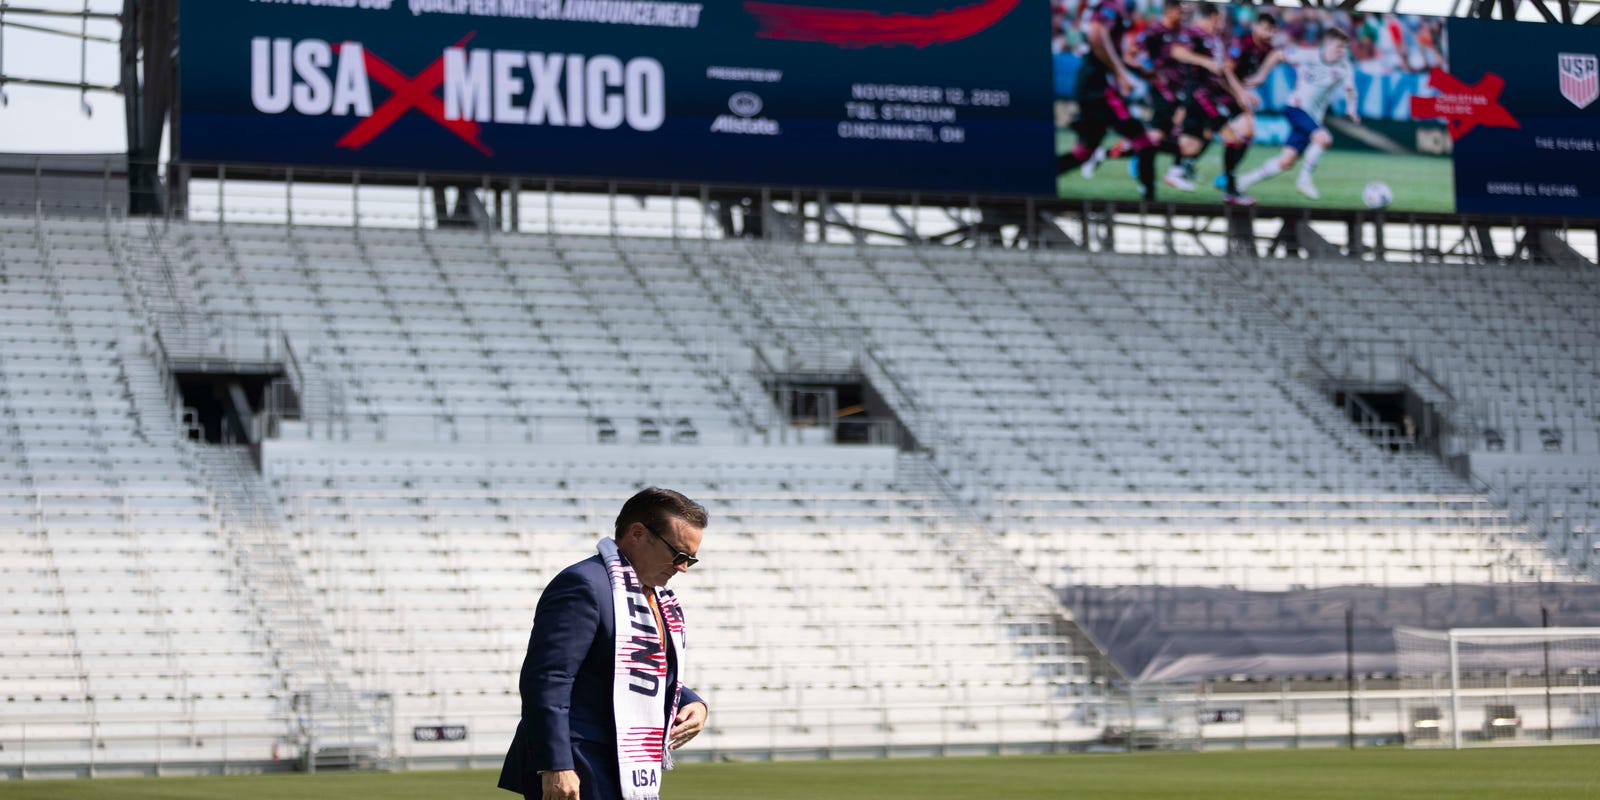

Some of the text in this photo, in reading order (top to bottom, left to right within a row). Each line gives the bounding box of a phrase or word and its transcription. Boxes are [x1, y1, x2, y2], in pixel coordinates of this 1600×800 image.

[562, 0, 703, 28] ANNOUNCEMENT
[251, 36, 374, 118] USA
[443, 47, 666, 132] MEXICO
[852, 83, 943, 103] NOVEMBER
[881, 103, 956, 123] STADIUM
[710, 114, 779, 135] Allstate
[632, 769, 657, 787] USA
